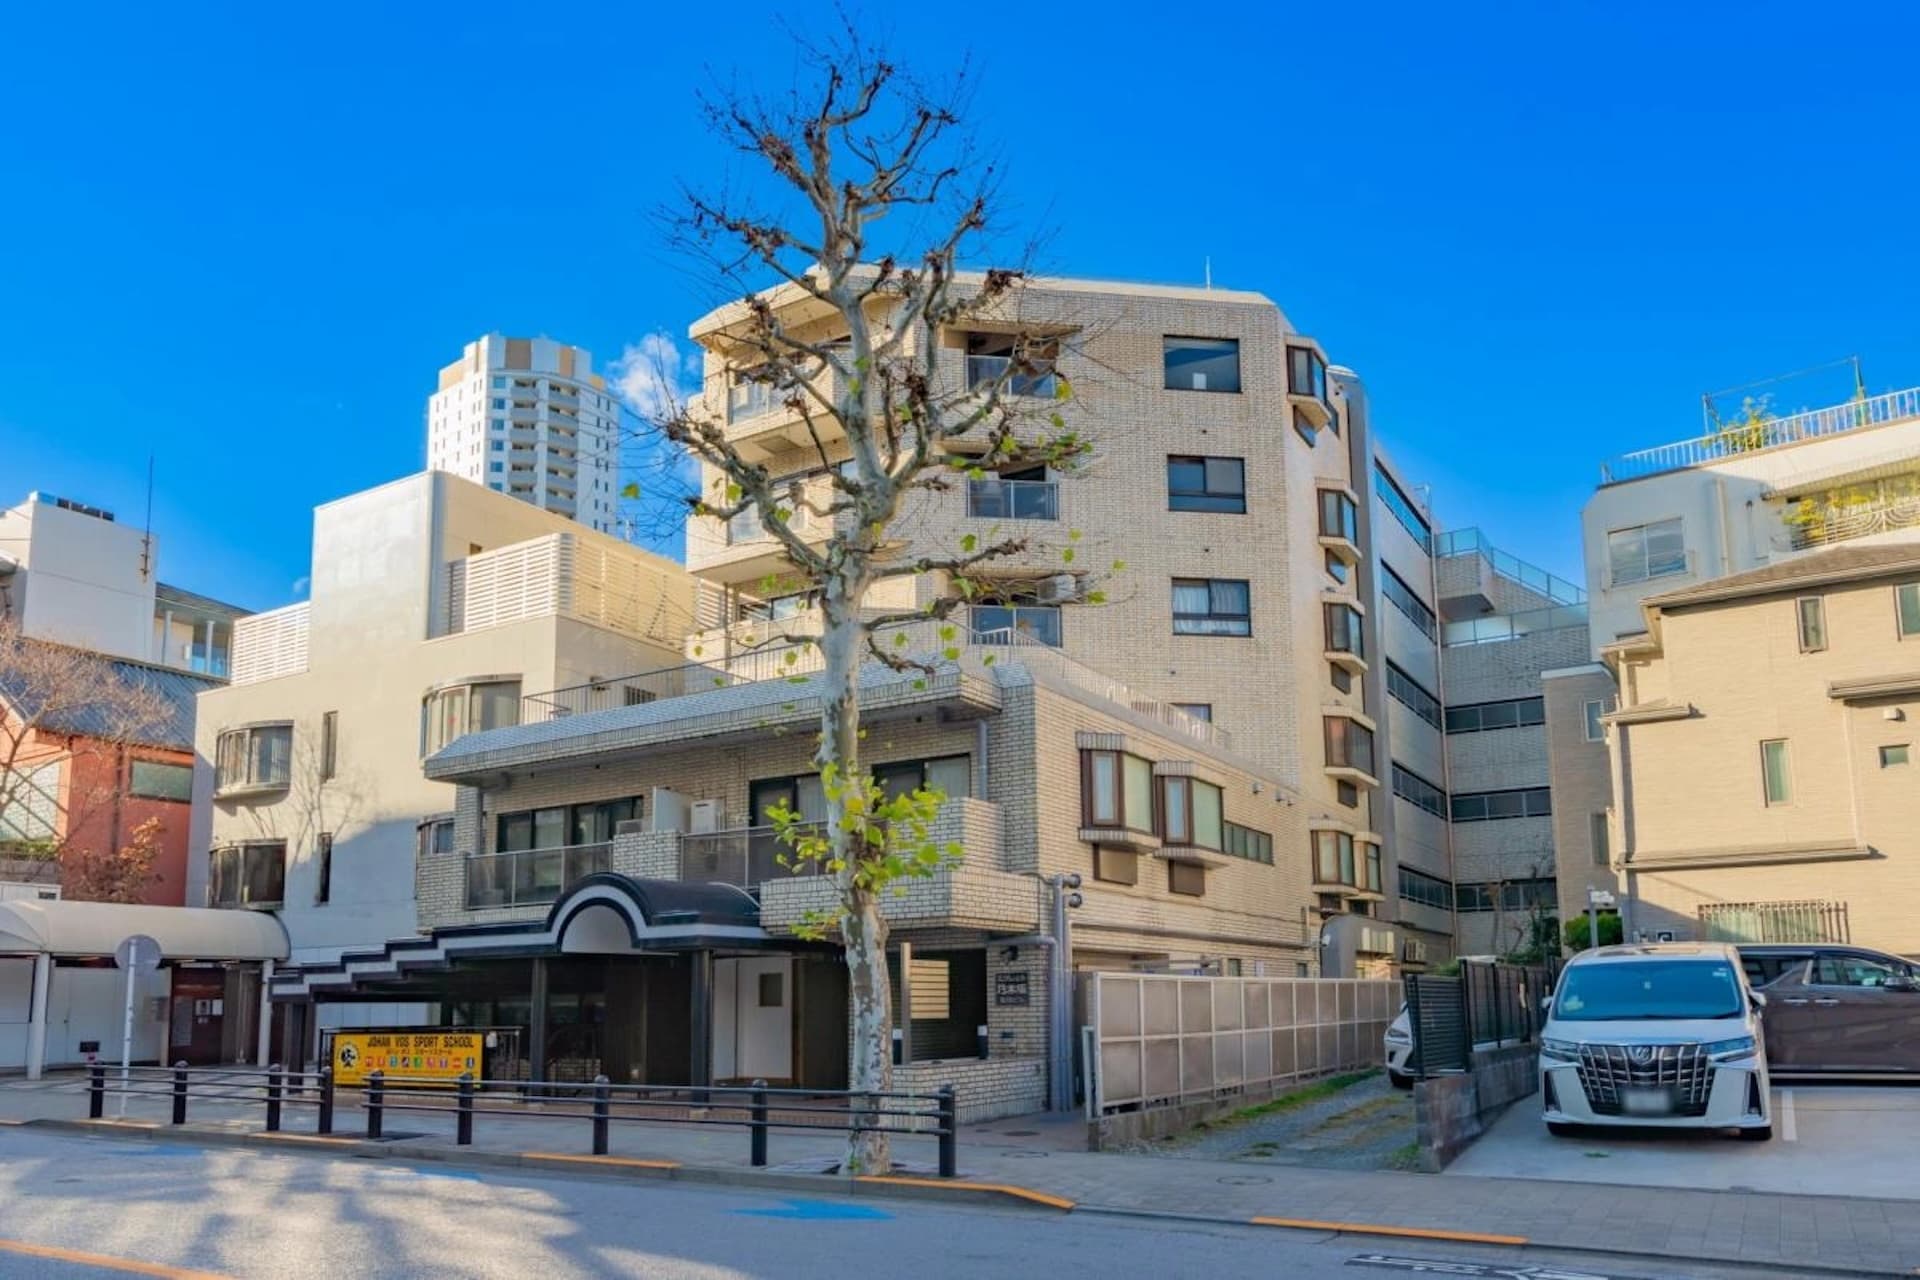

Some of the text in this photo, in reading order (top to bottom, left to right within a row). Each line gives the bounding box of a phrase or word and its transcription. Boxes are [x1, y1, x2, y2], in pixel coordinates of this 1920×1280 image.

[368, 1036, 473, 1048] JOHAN VOS SPORT SCHOOL
